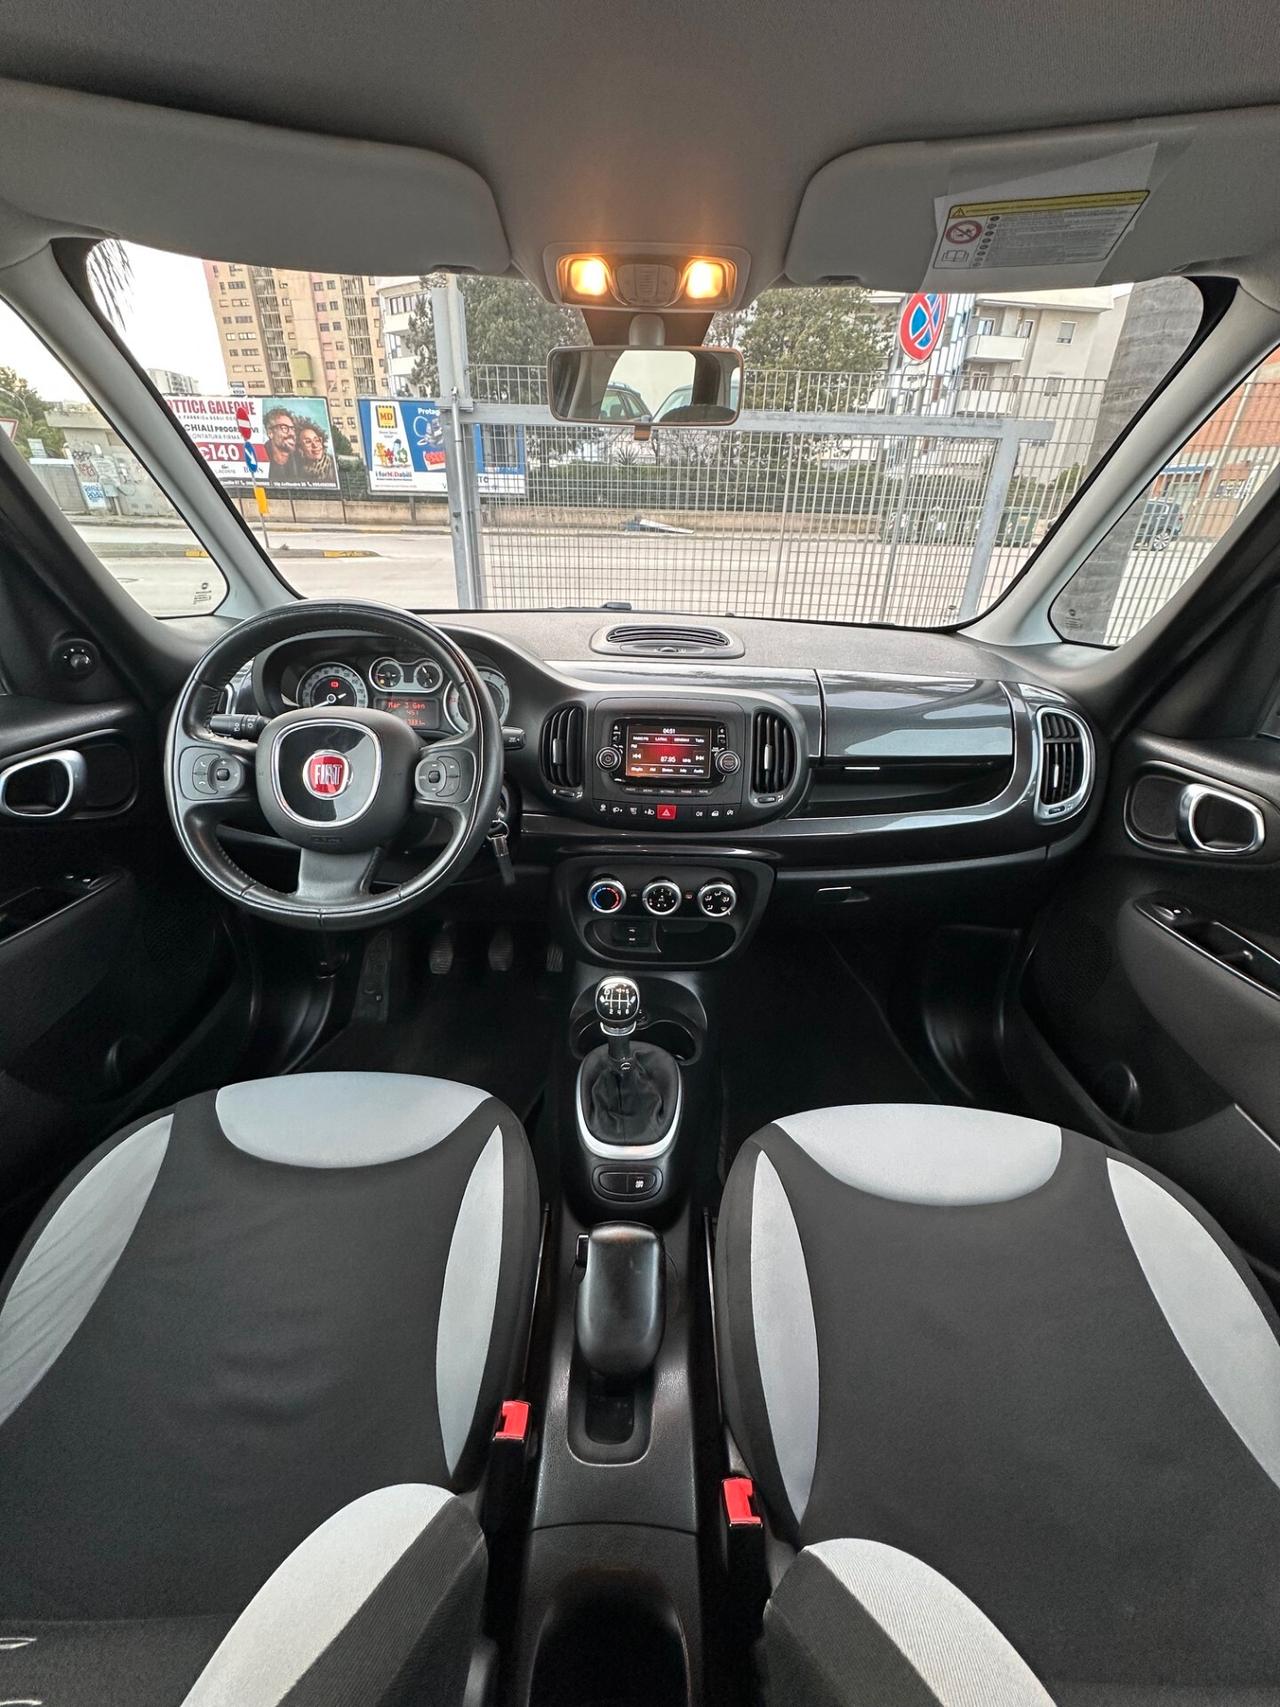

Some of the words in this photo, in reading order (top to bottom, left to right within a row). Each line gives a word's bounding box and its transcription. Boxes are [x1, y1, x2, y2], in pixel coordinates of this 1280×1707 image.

[380, 412, 393, 421] MD
[184, 421, 214, 432] CHIALI
[315, 764, 341, 785] FIAT
